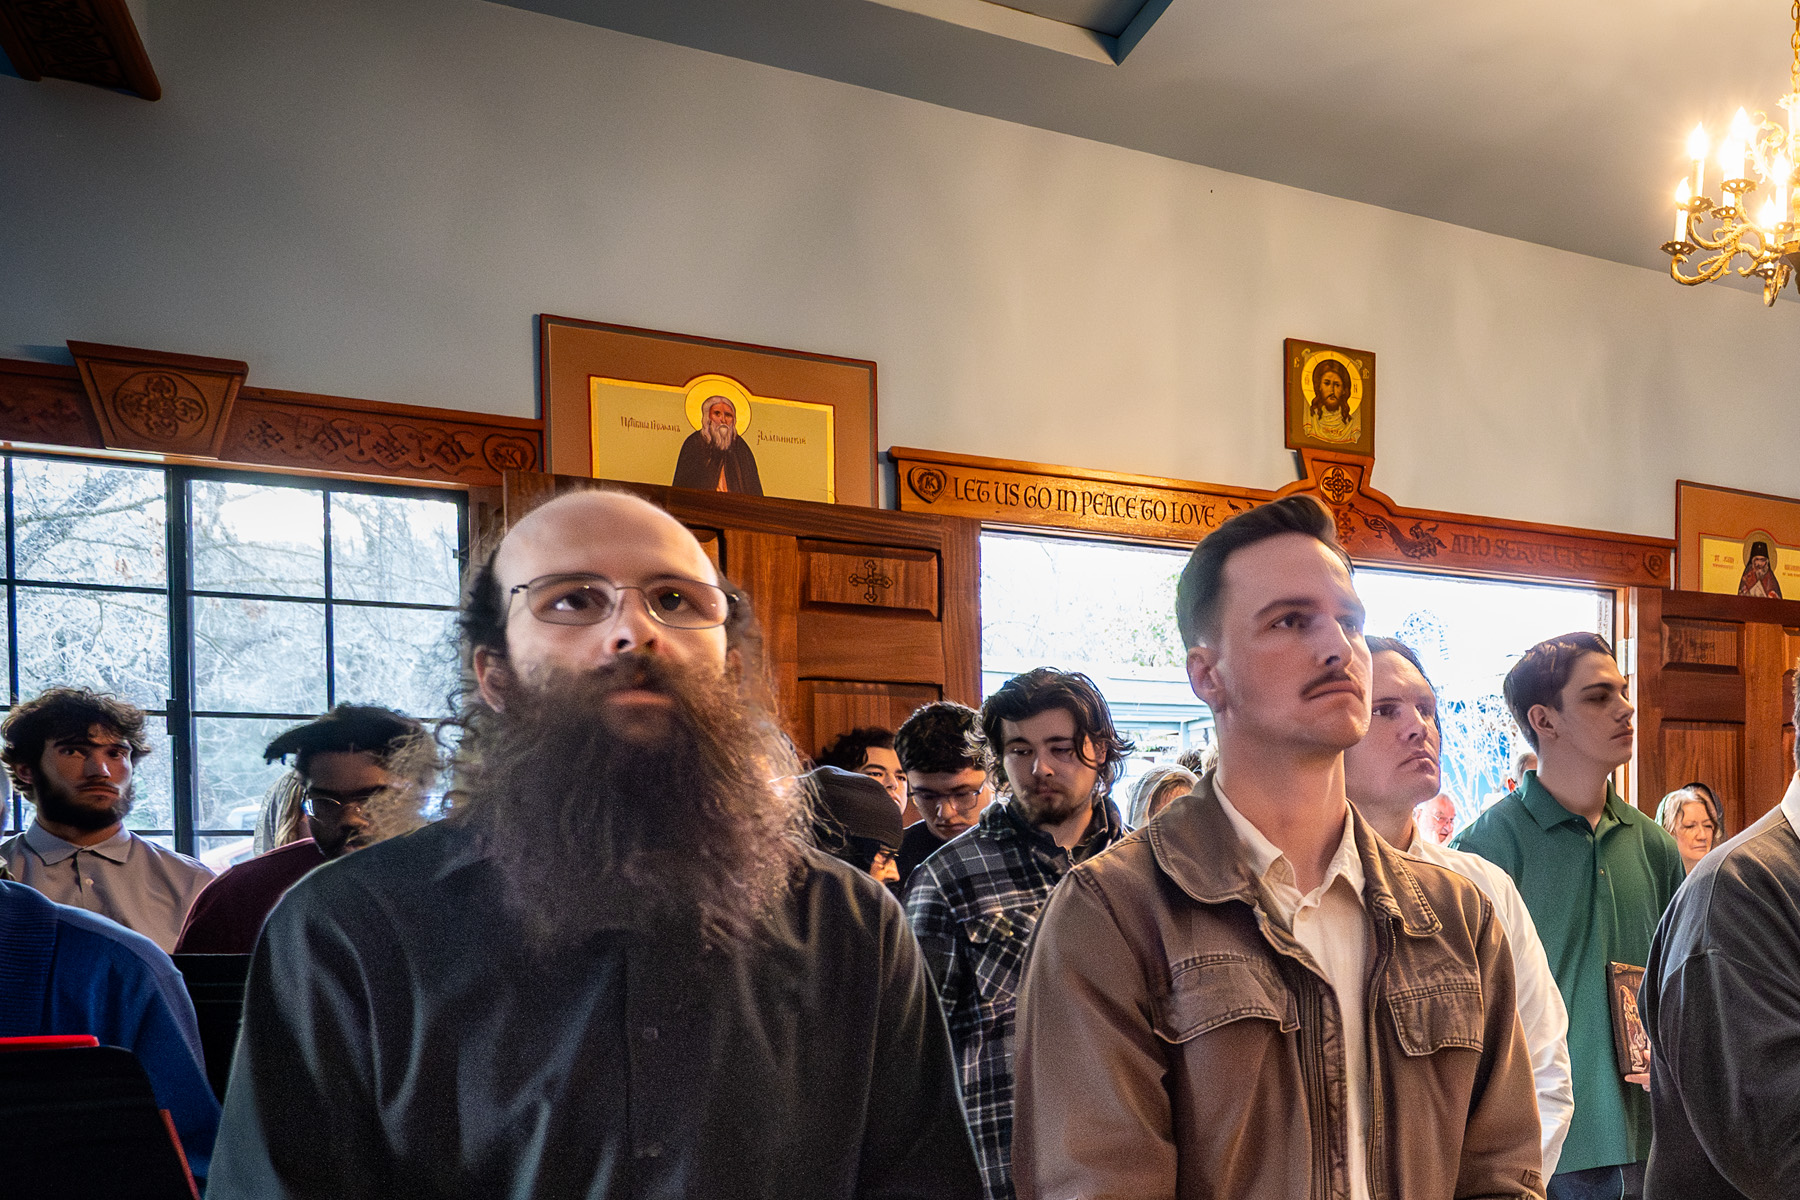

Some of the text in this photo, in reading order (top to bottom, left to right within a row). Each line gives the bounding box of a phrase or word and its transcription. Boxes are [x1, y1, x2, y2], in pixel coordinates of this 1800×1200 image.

[954, 477, 1216, 528] LET US GO IN PEACE TO LOVE
[1450, 532, 1490, 556] AND
